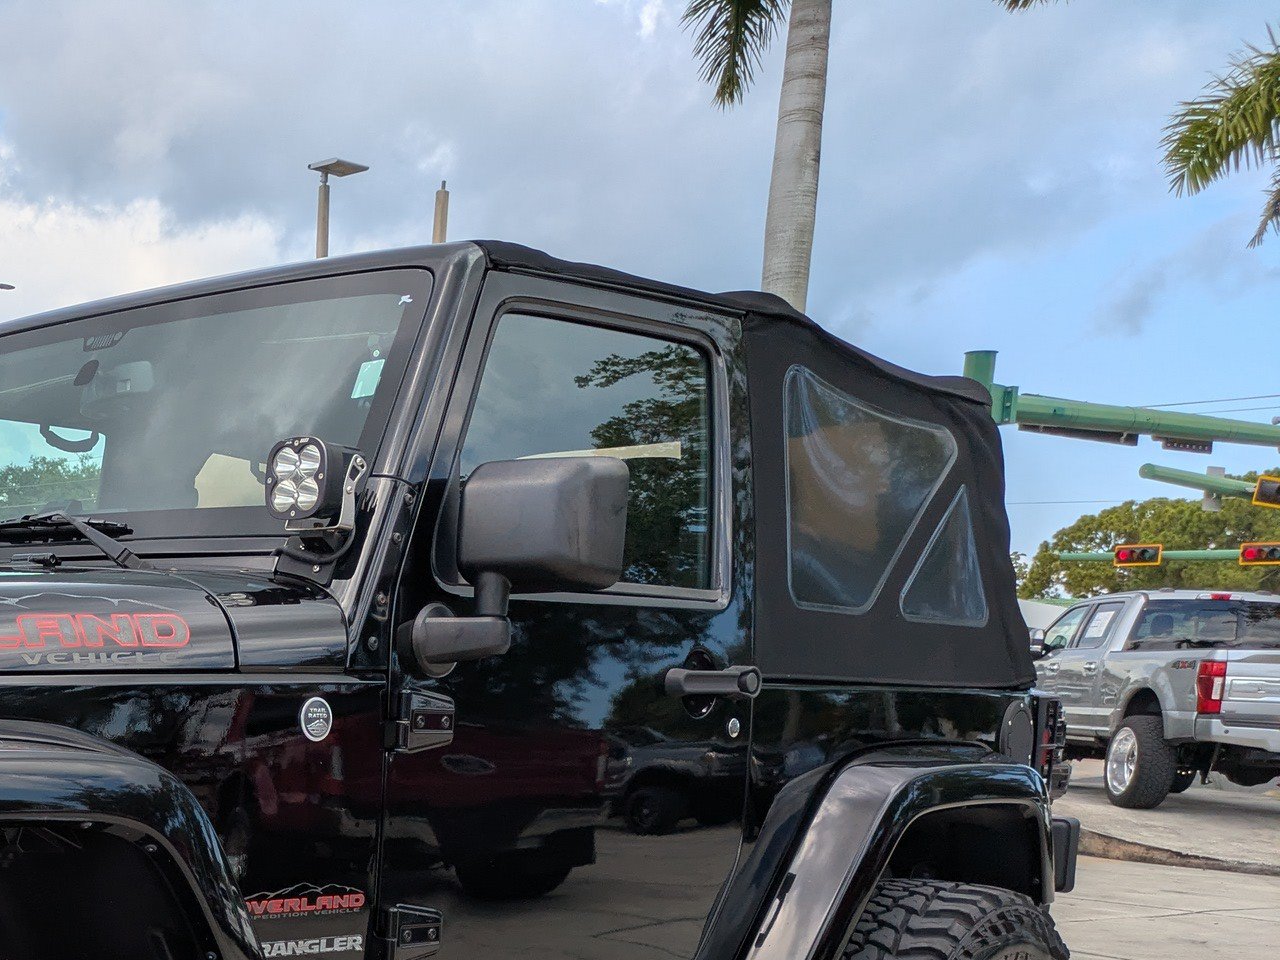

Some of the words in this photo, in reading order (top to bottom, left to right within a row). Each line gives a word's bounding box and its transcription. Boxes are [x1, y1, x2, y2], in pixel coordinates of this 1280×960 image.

[21, 650, 183, 665] VEHICLE
[246, 893, 365, 915] VERLAND
[251, 911, 308, 920] PEDITION
[314, 908, 360, 916] VEHICLE
[261, 935, 363, 958] RANGLER
